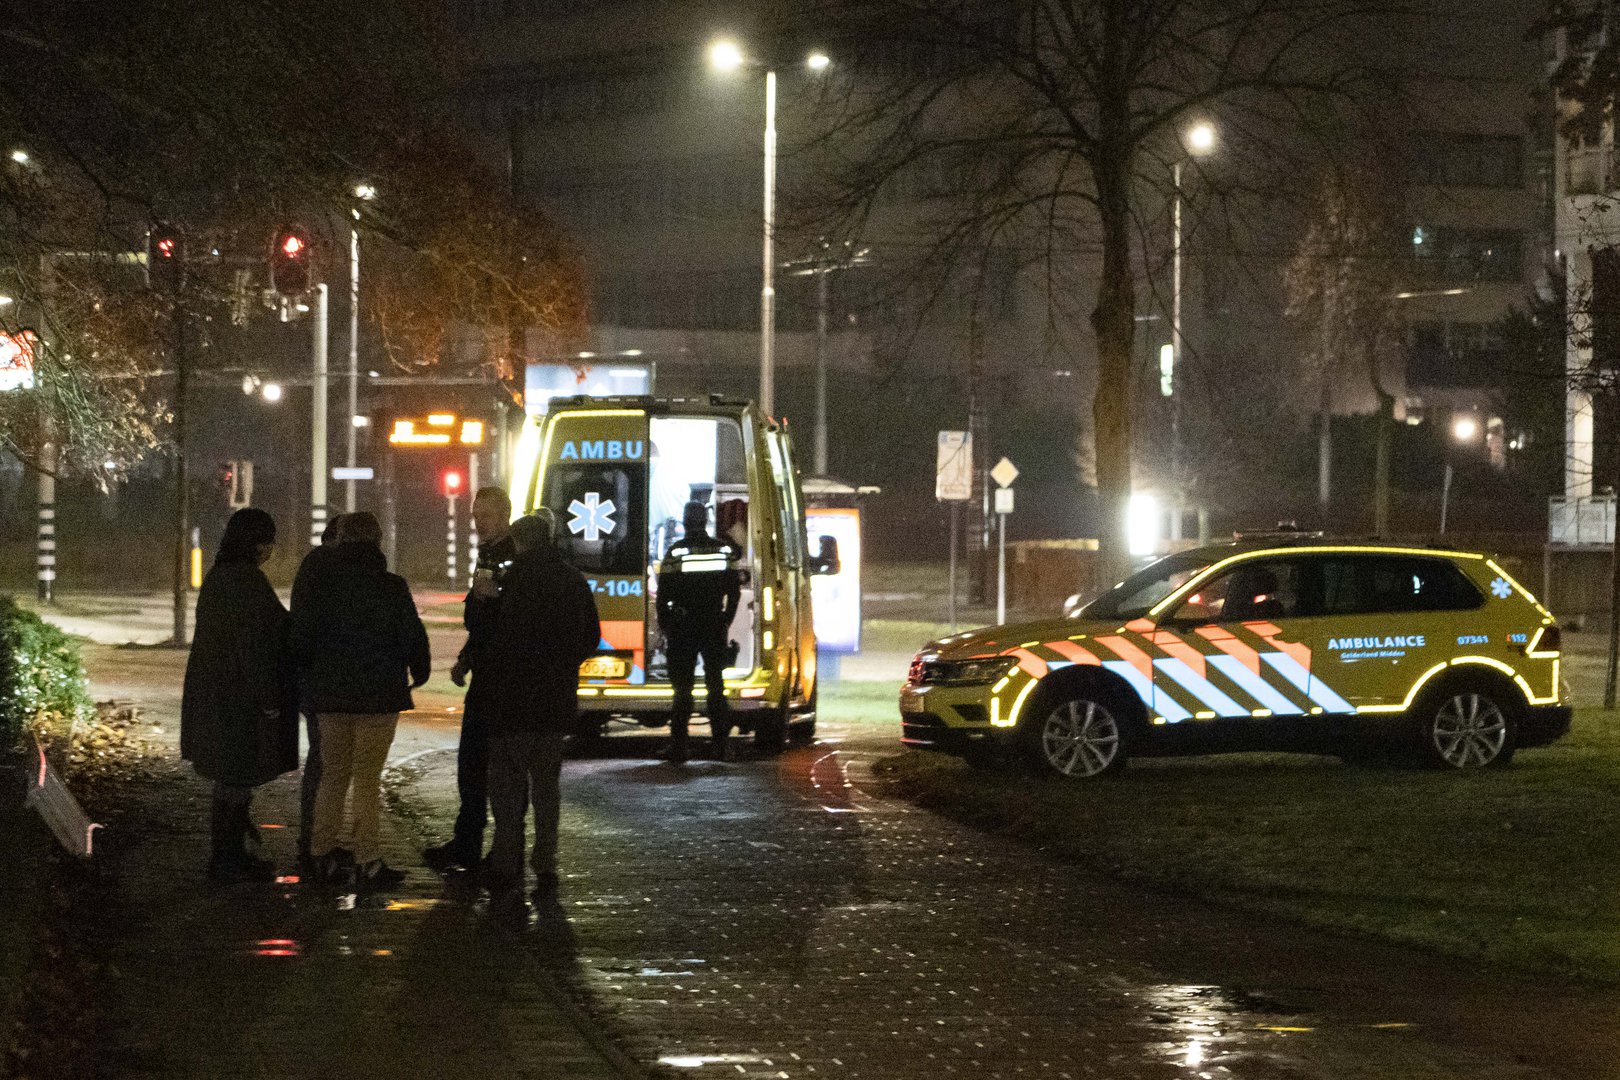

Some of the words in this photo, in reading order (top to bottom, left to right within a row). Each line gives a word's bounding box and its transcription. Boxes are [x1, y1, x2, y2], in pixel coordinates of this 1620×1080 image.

[560, 440, 643, 460] AMBU
[1327, 635, 1426, 650] AMBULANCE
[1511, 633, 1528, 643] 112
